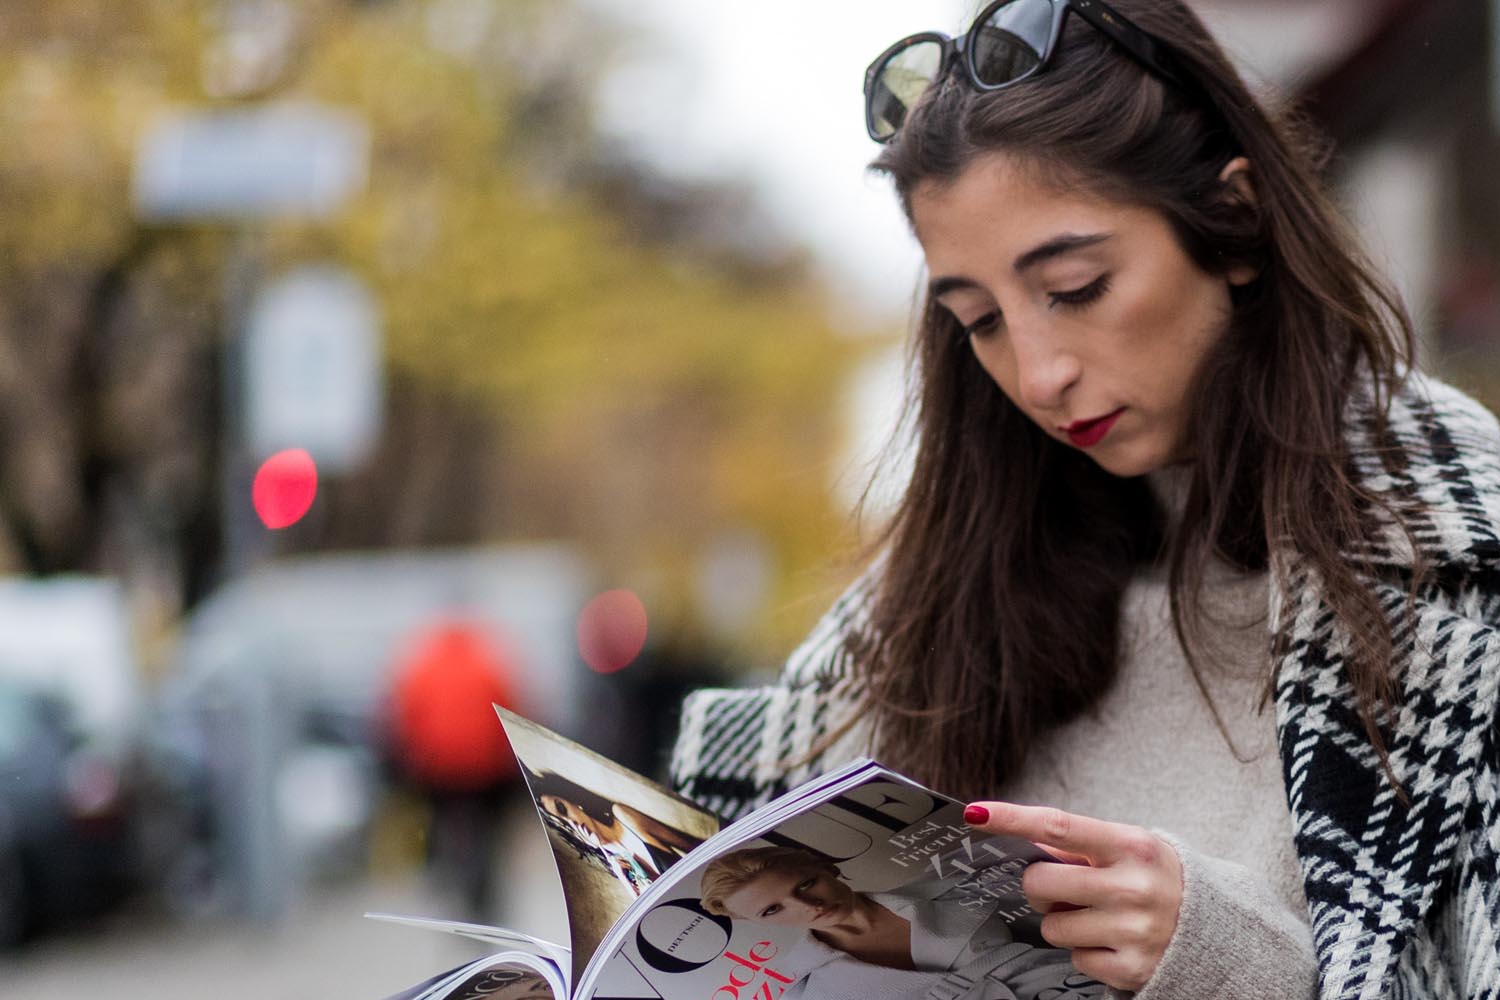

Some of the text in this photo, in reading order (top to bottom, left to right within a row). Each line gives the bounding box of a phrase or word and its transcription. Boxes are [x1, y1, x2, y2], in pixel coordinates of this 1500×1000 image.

[888, 820, 944, 850] Best
[929, 836, 1029, 893] 44 Seiten
[958, 876, 1026, 911] Schm
[667, 915, 704, 952] DEUTSCH
